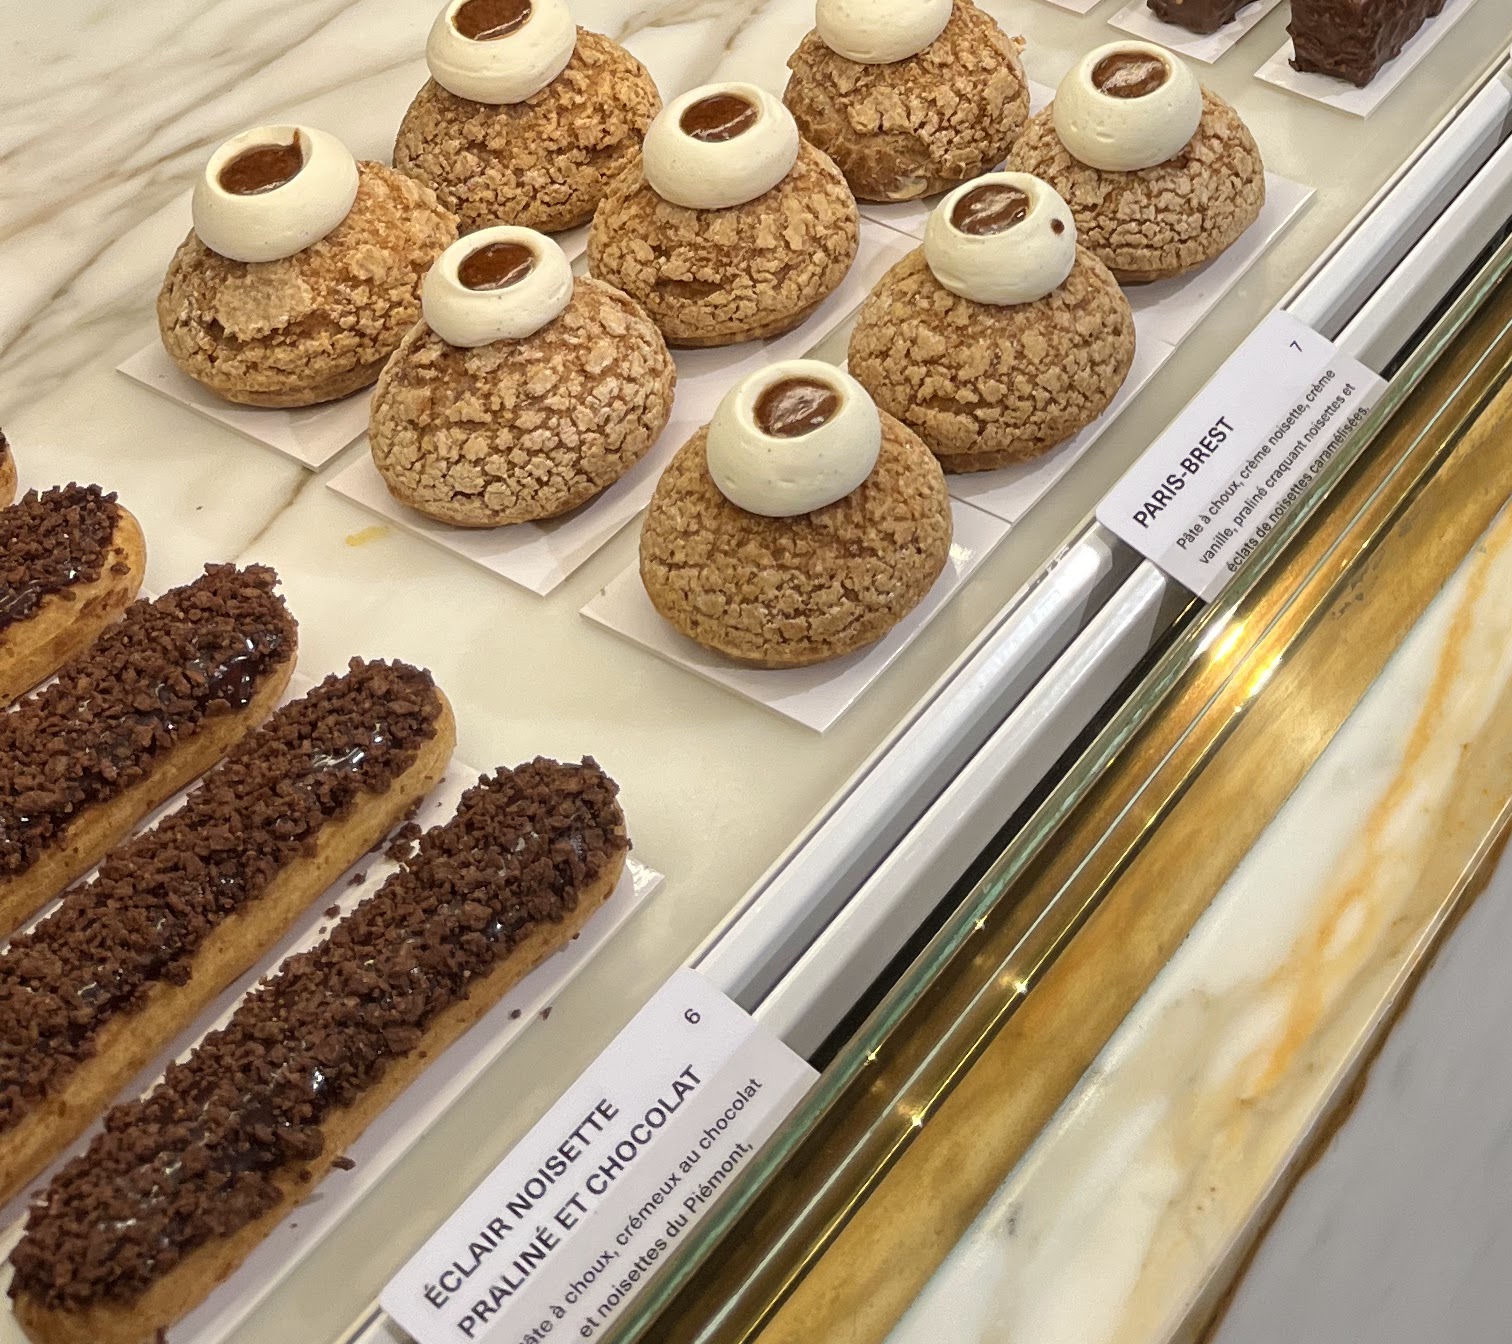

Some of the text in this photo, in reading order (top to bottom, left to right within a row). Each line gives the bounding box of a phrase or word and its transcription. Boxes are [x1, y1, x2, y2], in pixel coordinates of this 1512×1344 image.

[1289, 340, 1303, 353] 7
[1132, 415, 1234, 529] PARIS-BREST
[1176, 370, 1336, 550] Pâte à choux, crème noisette, crème
[1199, 383, 1356, 564] vanille, praliné craquant noisettes et
[1226, 536, 1259, 573] éclats
[1255, 521, 1271, 539] de
[1268, 472, 1312, 524] noisettes
[684, 1008, 701, 1025] 6
[423, 1098, 620, 1310] ÉCLAIR NOISETTE
[457, 1063, 701, 1339] PRALINÉ ET CHOCOLAT
[519, 1078, 763, 1344] âte à choux, crémeux au chocolat
[579, 1143, 754, 1338] et noisettes du Piémont,
